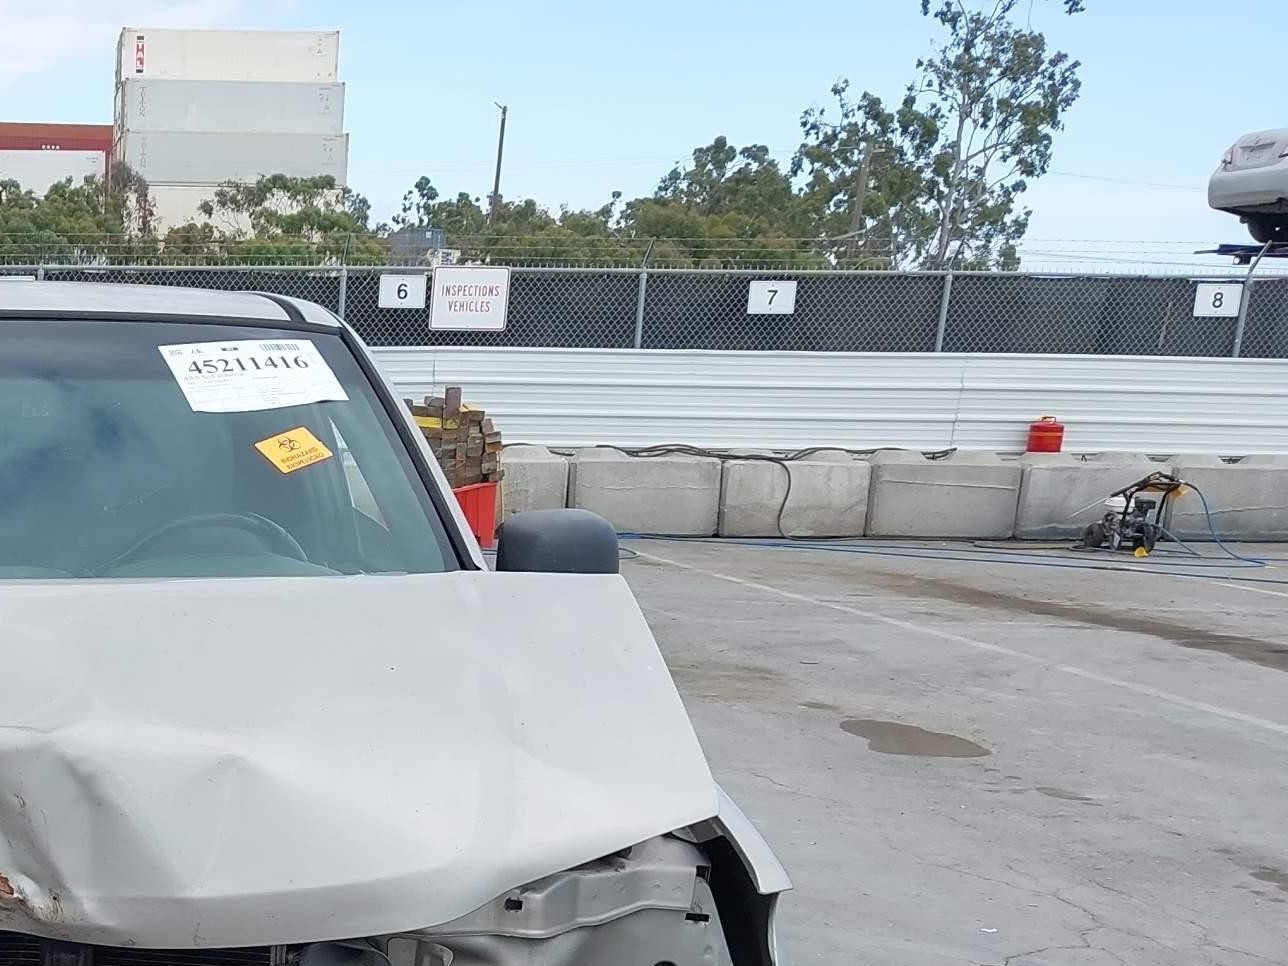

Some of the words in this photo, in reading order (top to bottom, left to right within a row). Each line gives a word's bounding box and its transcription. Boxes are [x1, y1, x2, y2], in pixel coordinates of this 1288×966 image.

[135, 43, 145, 70] TAL
[396, 283, 409, 300] 6
[441, 284, 500, 297] INSPECTIONS
[767, 289, 779, 306] 7
[448, 300, 490, 313] VEHICLES
[1212, 291, 1224, 309] 8
[188, 355, 309, 374] 45211416
